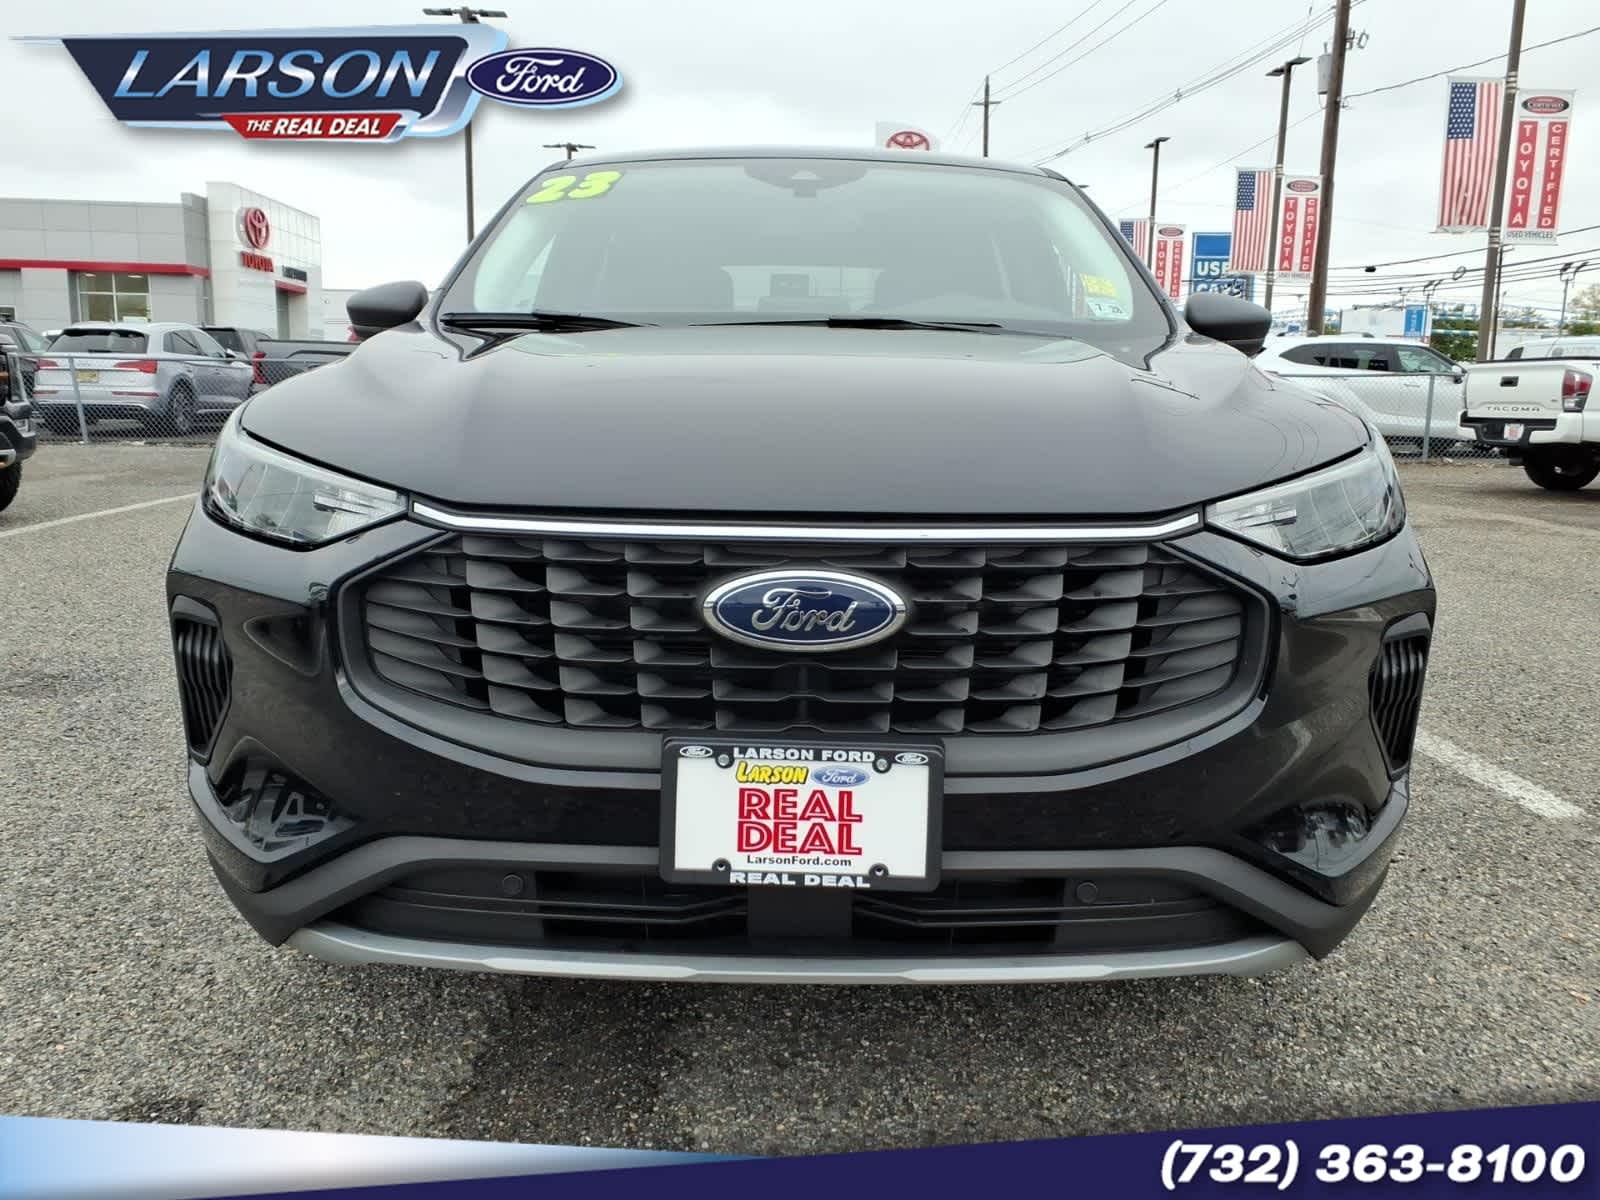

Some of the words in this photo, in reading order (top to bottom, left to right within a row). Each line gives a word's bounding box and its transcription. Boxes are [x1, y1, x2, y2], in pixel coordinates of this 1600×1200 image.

[526, 171, 622, 204] 23
[1512, 125, 1534, 225] TOYOTA
[1541, 124, 1562, 227] CERTIFIED
[1281, 200, 1296, 269] TOYOTA
[1301, 199, 1316, 270] CERTIFIED
[751, 588, 858, 632] Ford
[733, 747, 814, 761] LARSON
[821, 750, 875, 762] FORD
[736, 761, 809, 784] LARSON
[822, 768, 857, 783] Ford
[738, 788, 863, 823] REAL
[737, 821, 863, 855] DEAL
[747, 855, 852, 867] LarsonFord.com
[730, 871, 796, 885] REAL
[804, 874, 871, 888] DEAL
